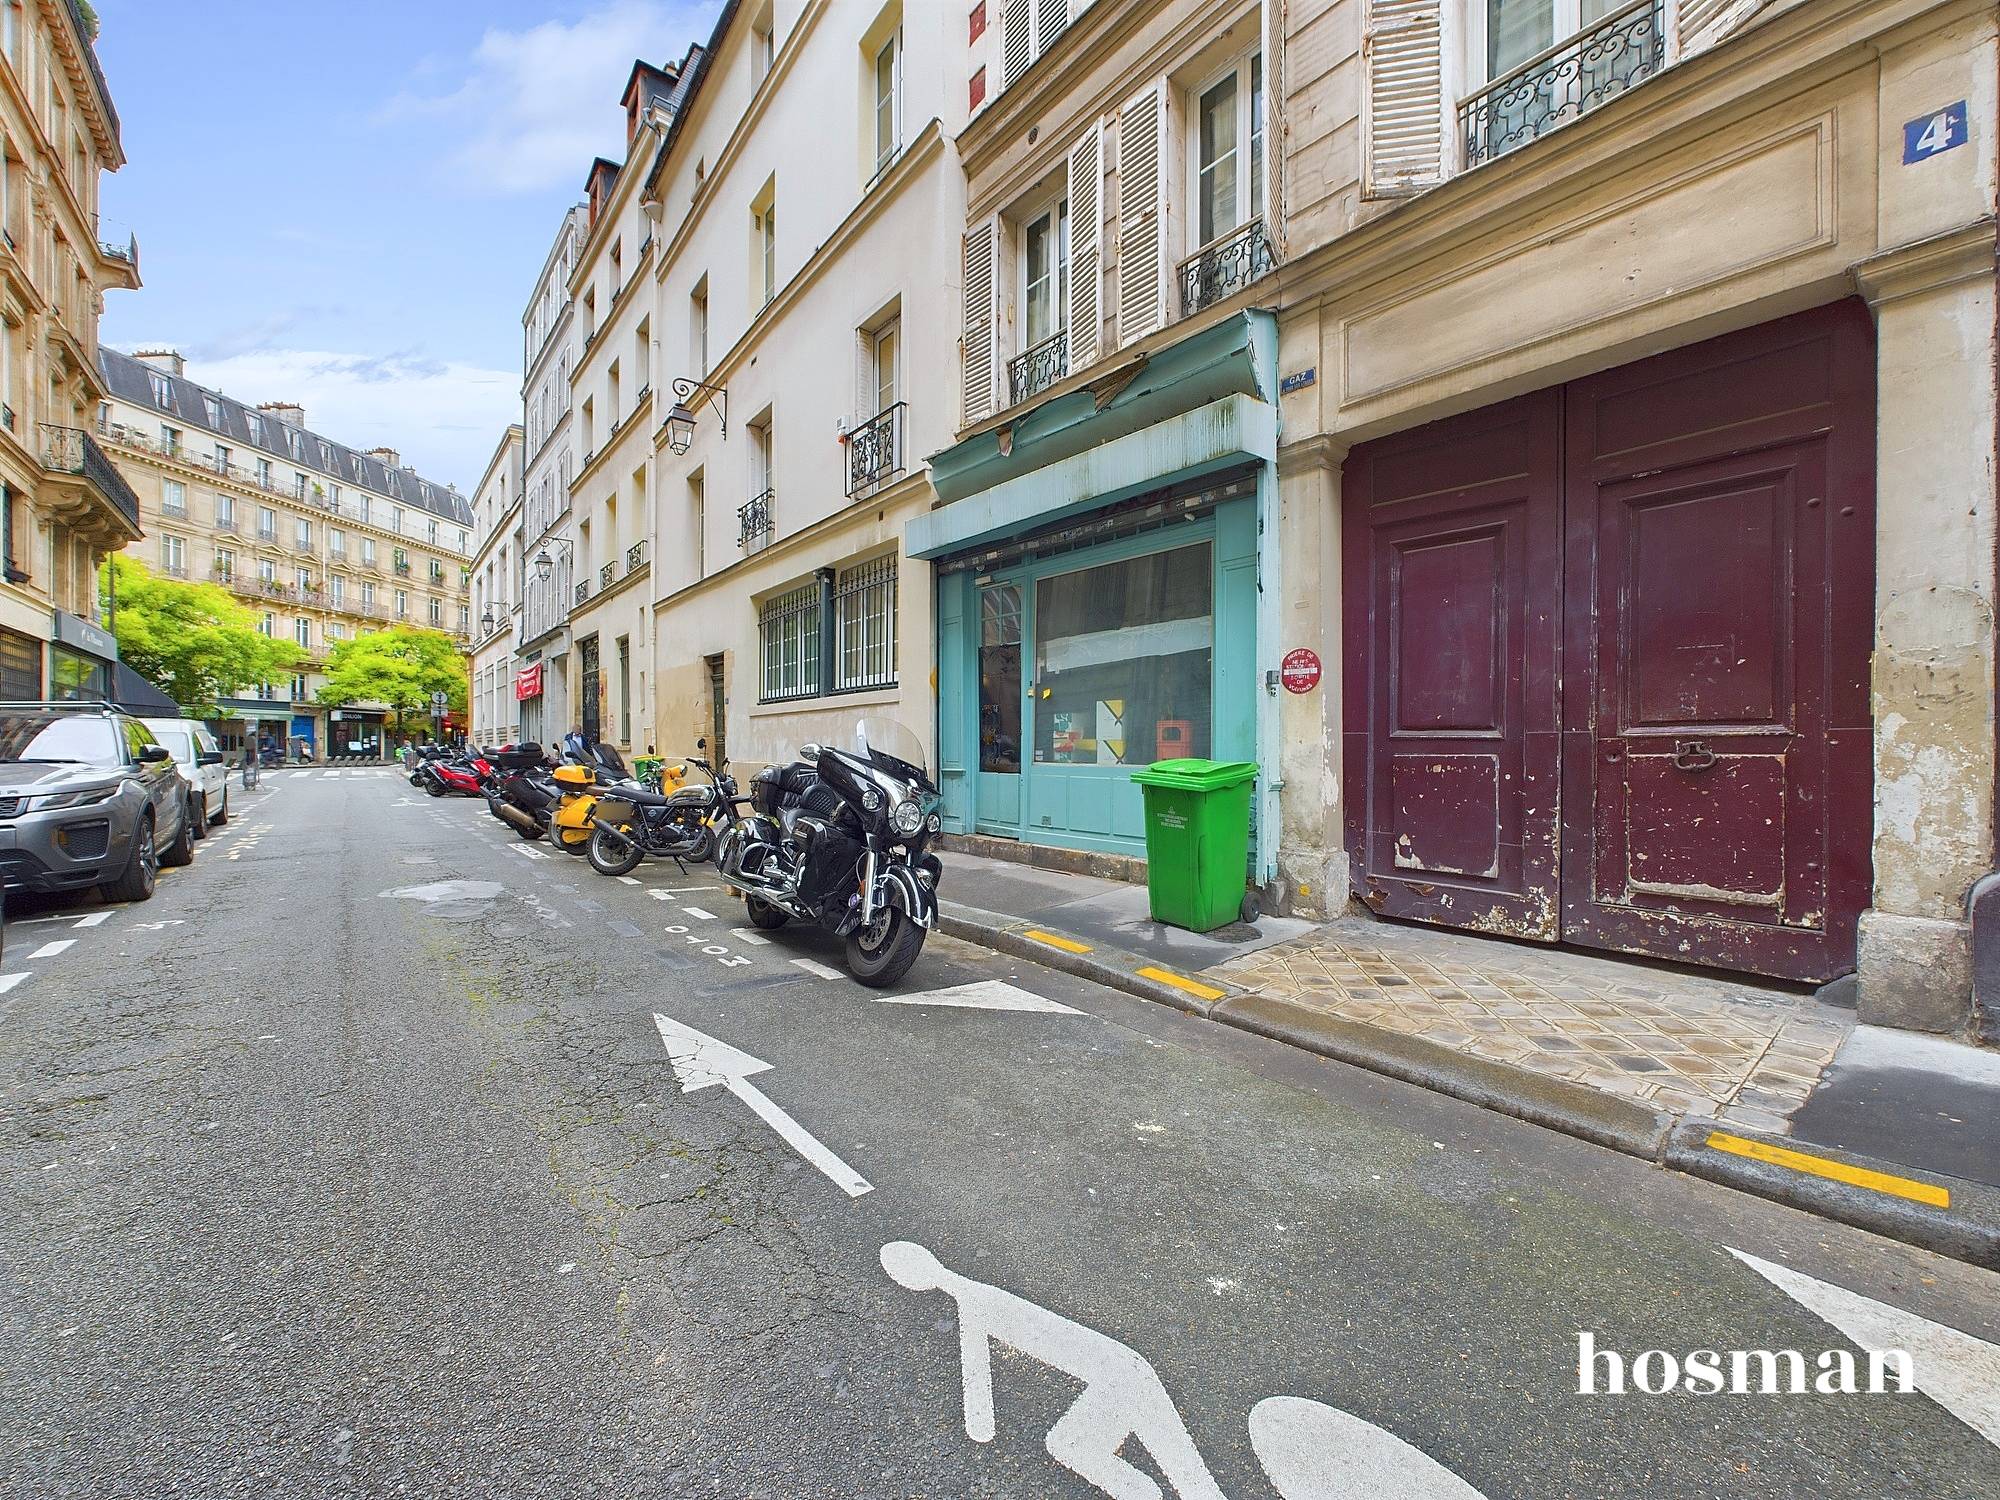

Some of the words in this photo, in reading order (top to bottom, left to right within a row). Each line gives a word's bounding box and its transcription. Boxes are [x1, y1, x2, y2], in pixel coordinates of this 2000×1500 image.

[1289, 371, 1307, 385] GAZ
[1306, 652, 1315, 660] DE
[664, 925, 753, 967] MOTO
